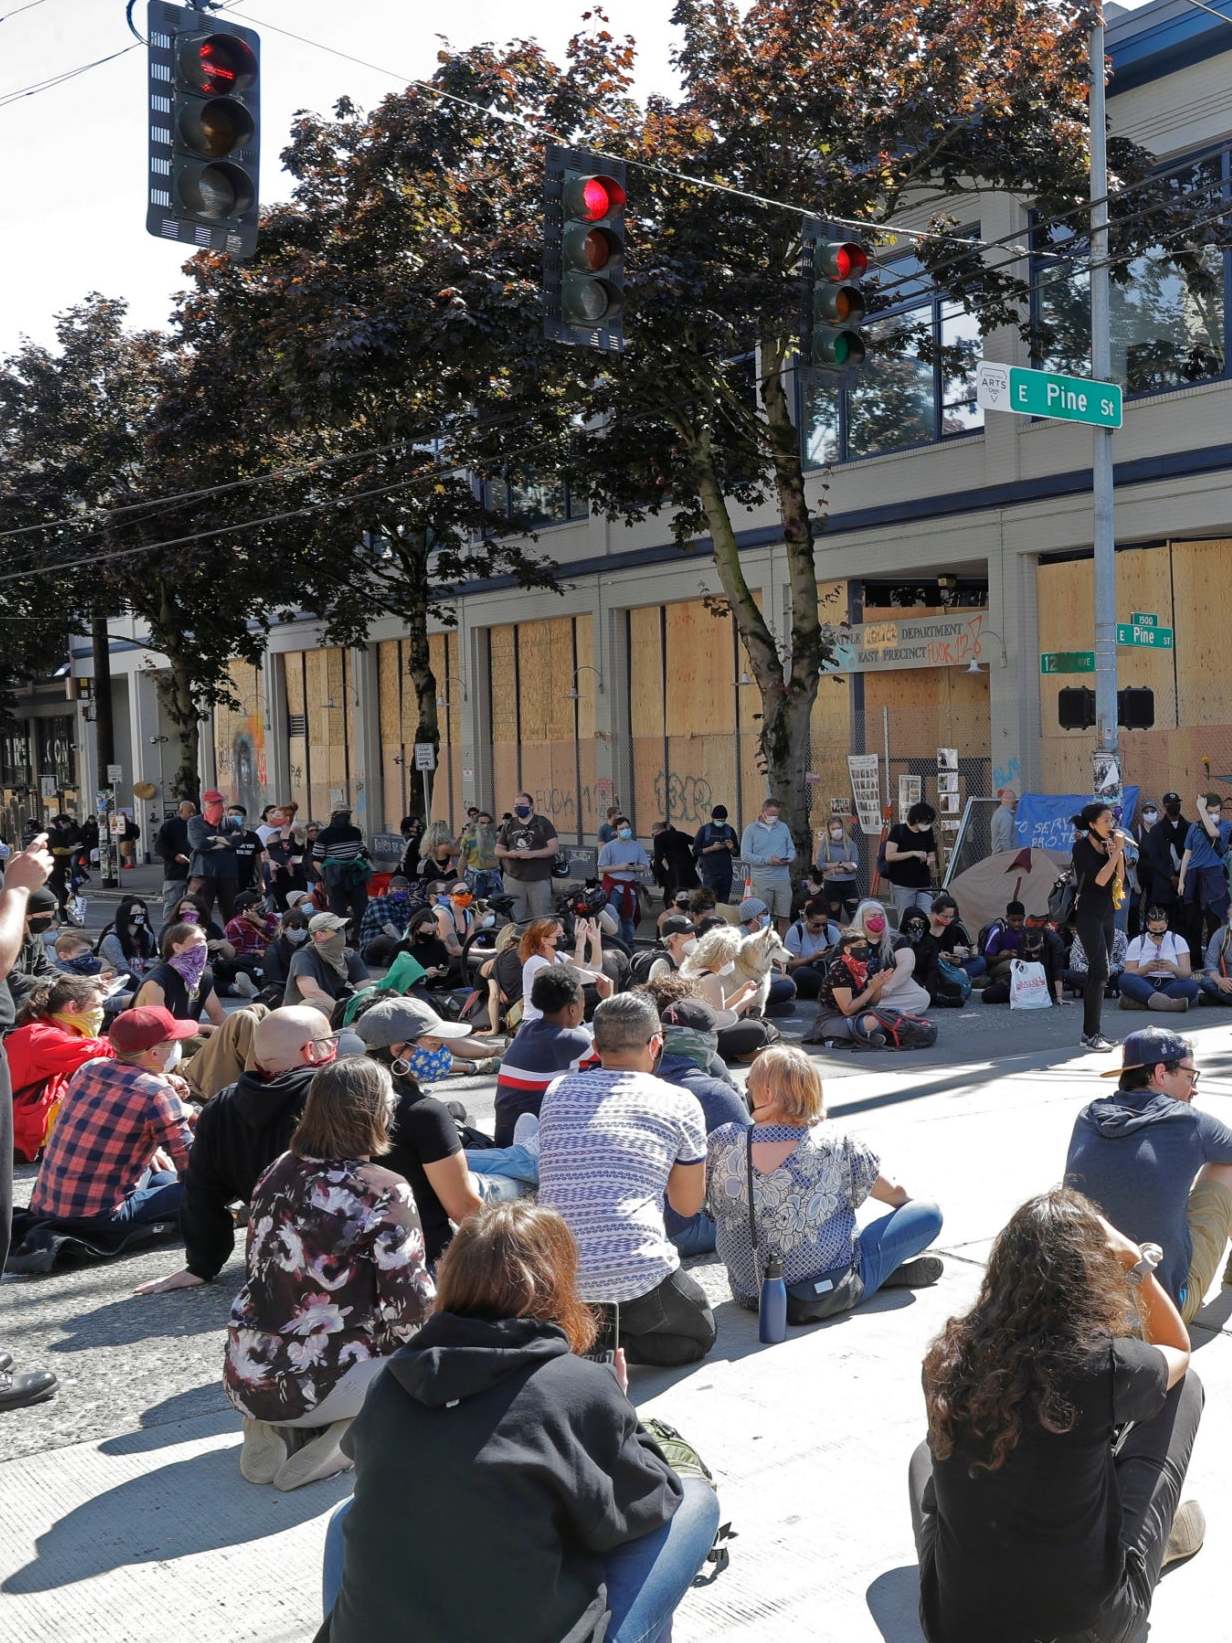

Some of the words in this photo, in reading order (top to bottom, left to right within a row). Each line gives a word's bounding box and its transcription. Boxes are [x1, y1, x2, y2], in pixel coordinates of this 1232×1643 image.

[982, 378, 1007, 389] ARTS
[1019, 384, 1028, 402] E
[1047, 383, 1088, 412] Pine
[1101, 399, 1114, 417] St
[1138, 615, 1154, 625] 1500
[901, 623, 964, 641] DEPARTMENT
[1119, 630, 1126, 641] E
[1133, 626, 1155, 644] Pine
[858, 650, 880, 664] EAST
[883, 646, 927, 662] PRECINCT
[1033, 815, 1078, 834] SERV
